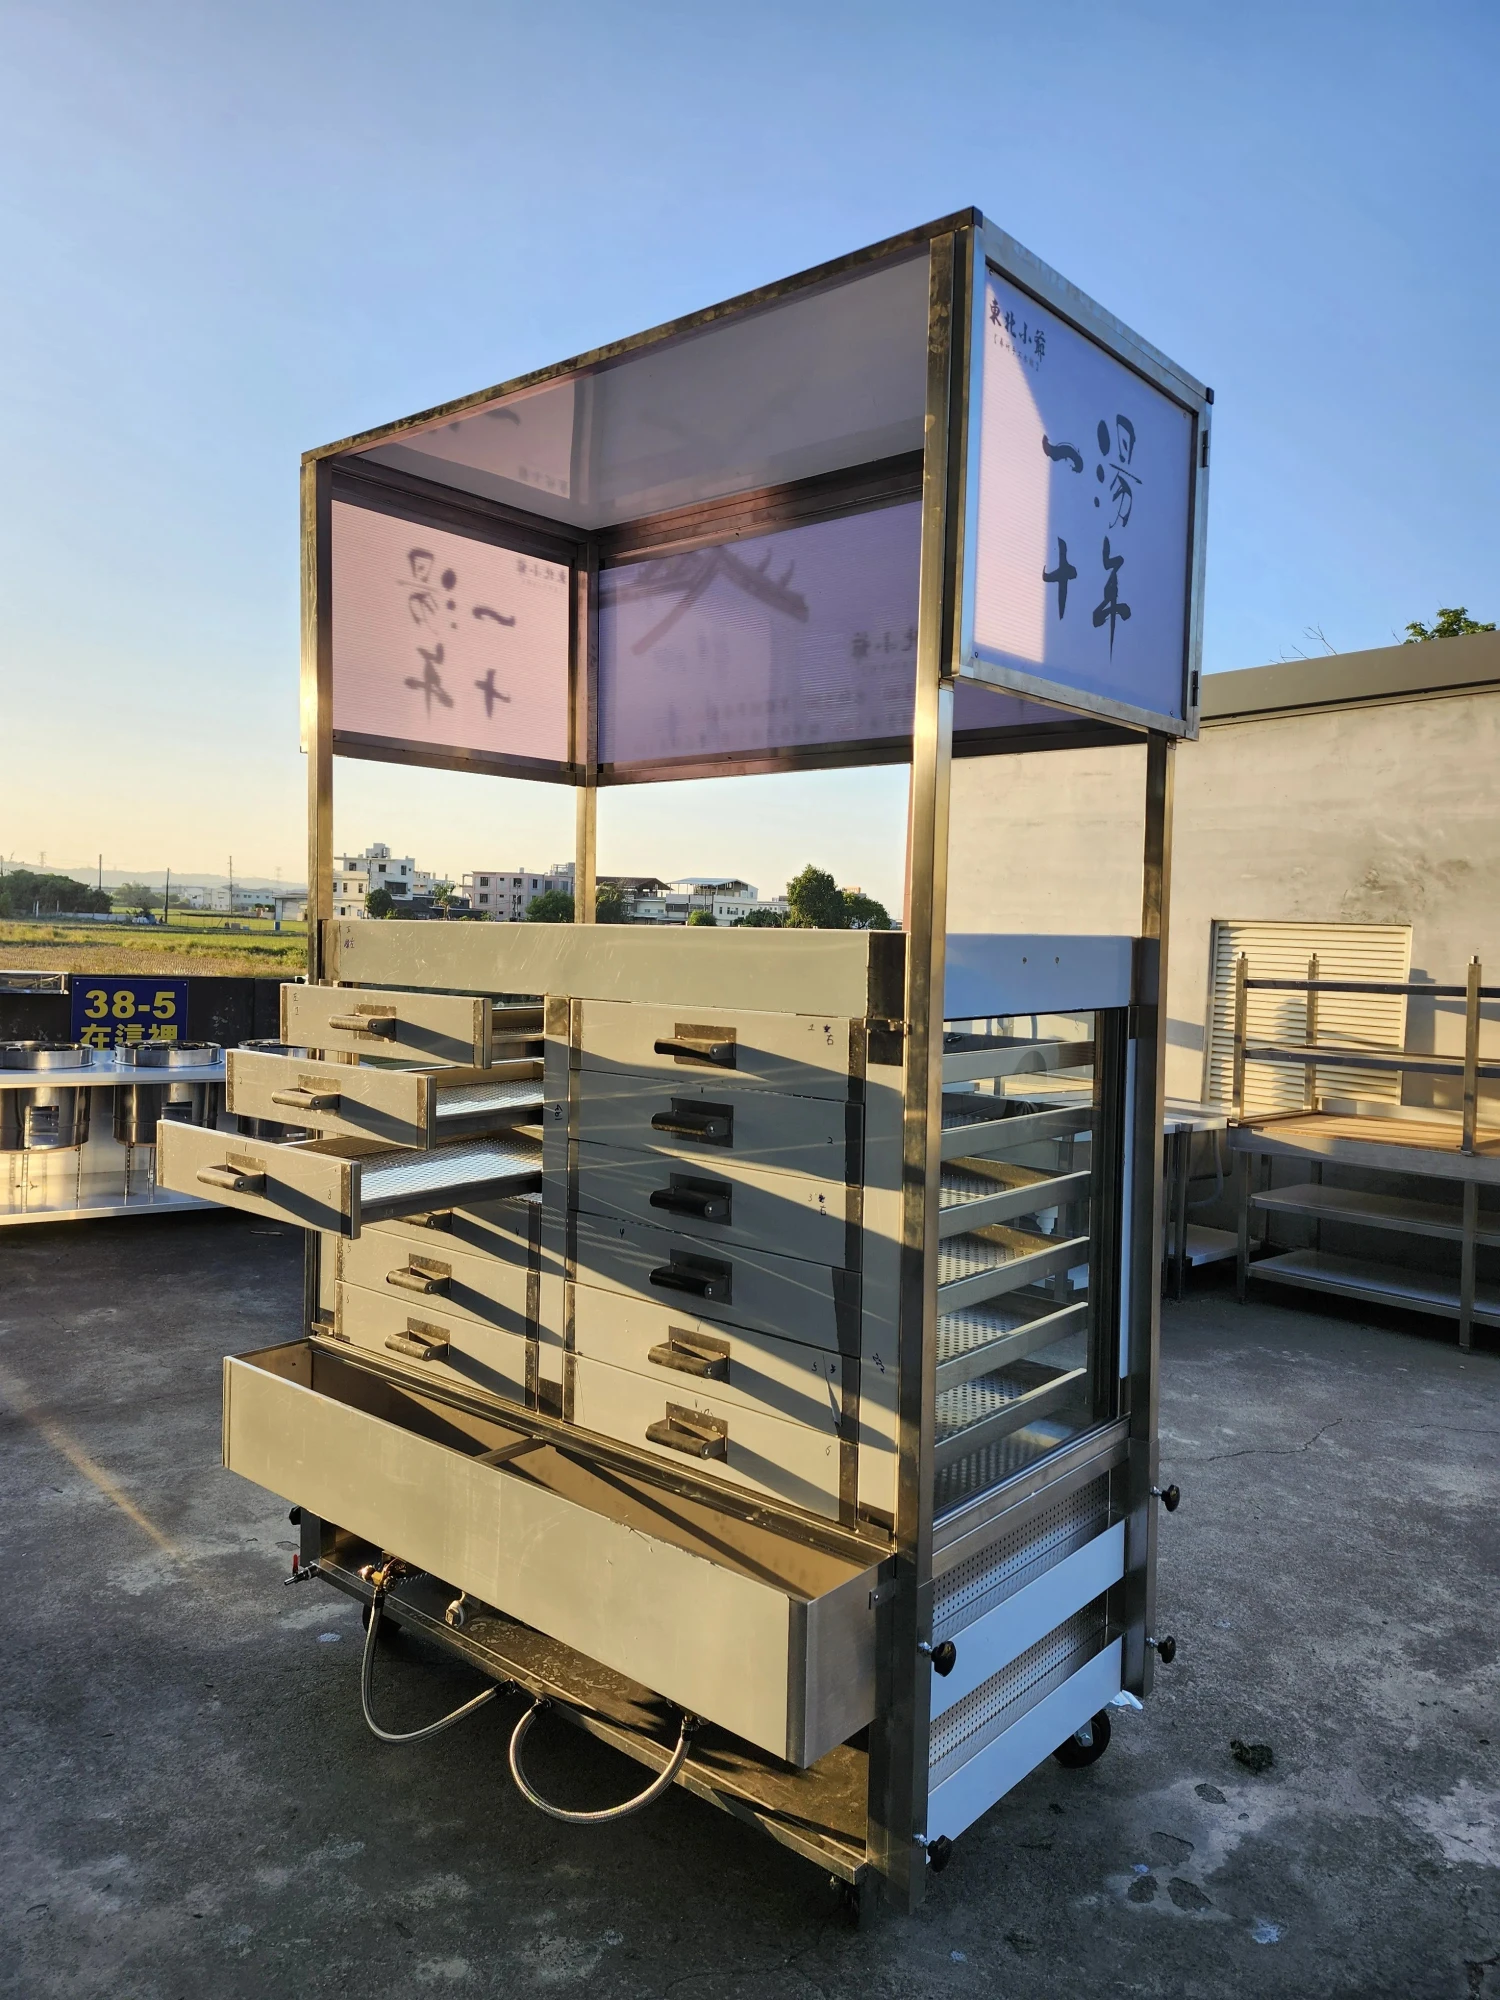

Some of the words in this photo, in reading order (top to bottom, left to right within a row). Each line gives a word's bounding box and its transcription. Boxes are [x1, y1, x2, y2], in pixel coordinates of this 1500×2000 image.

[990, 297, 1046, 363] 東北小爺
[84, 989, 176, 1019] 38-5
[80, 1023, 178, 1051] 在這裡
